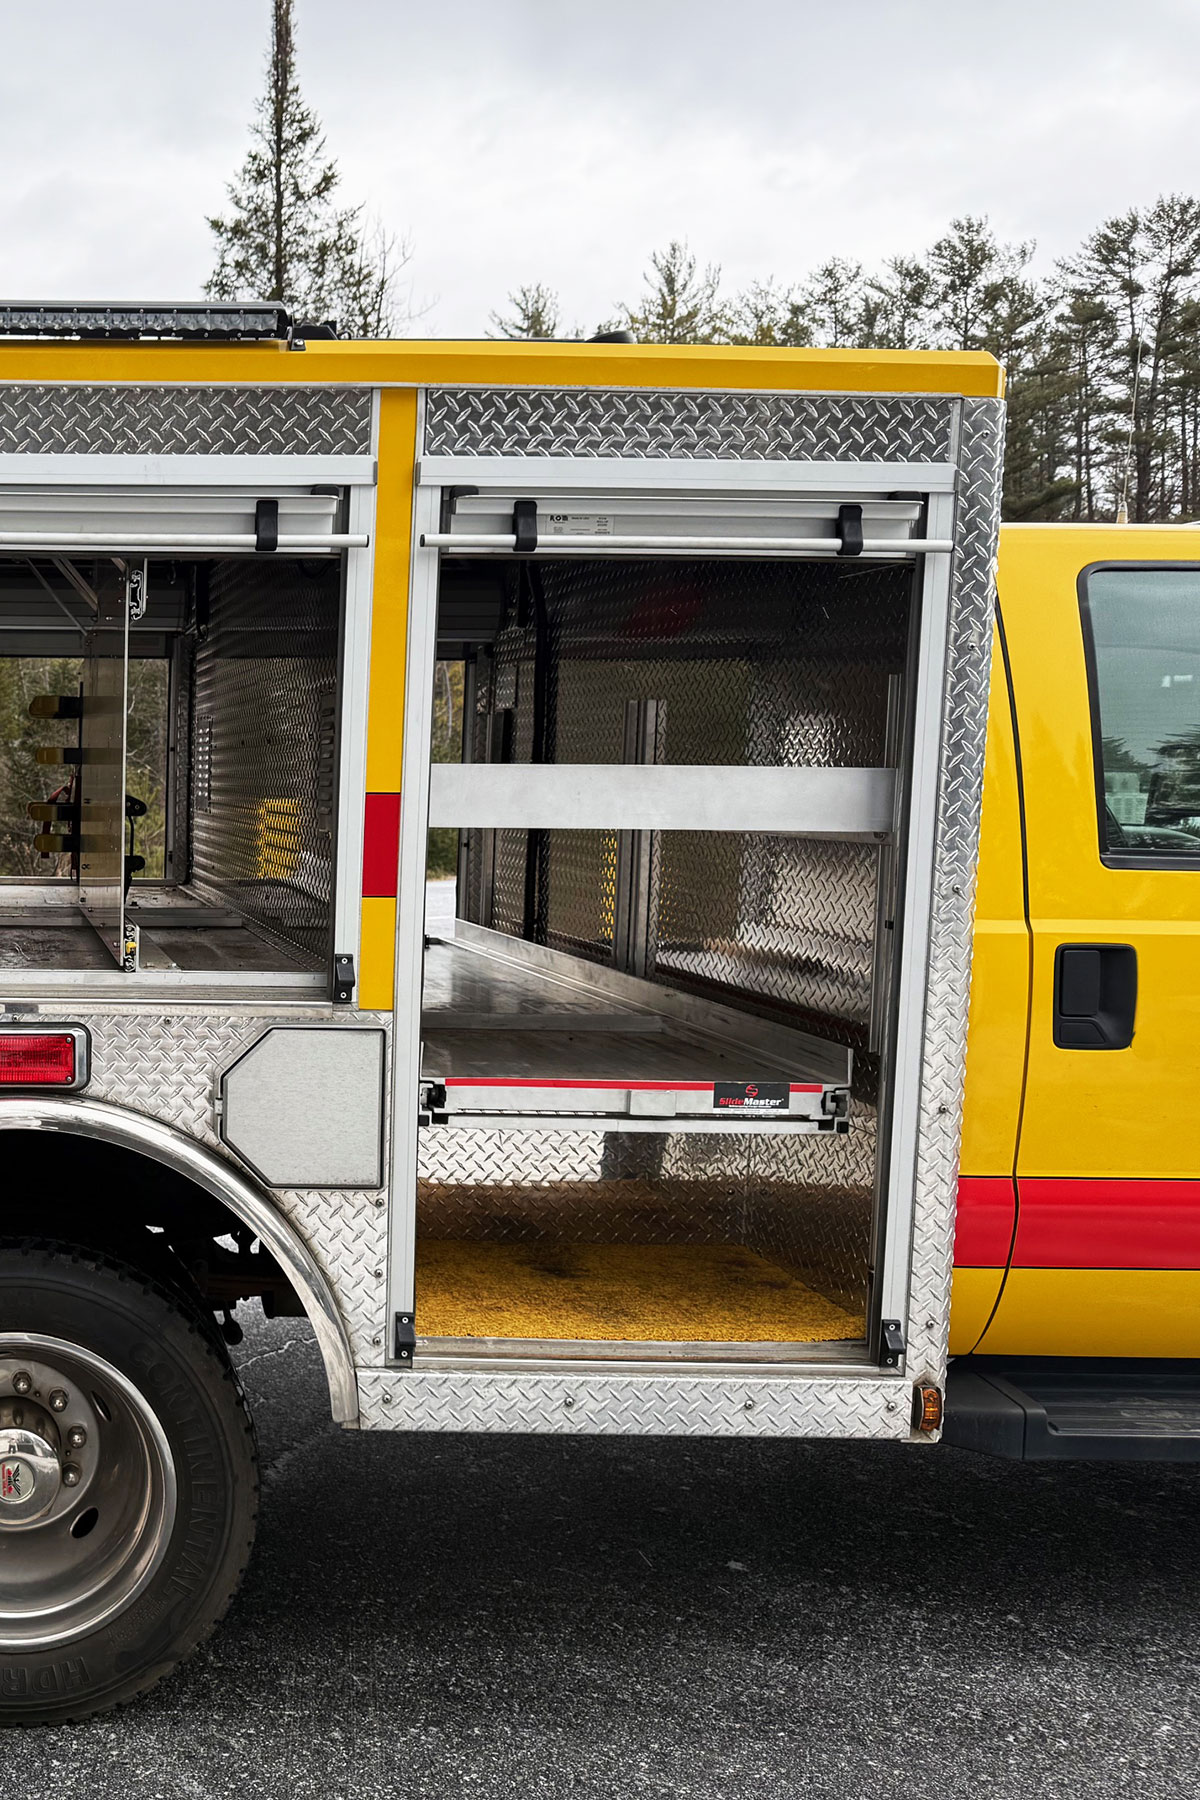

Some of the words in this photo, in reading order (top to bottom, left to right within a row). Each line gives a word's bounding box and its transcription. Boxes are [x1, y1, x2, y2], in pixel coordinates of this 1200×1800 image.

[719, 1097, 782, 1107] SlideMaster
[128, 1341, 218, 1600] CONTINENTAL
[1, 1656, 91, 1697] HDR
